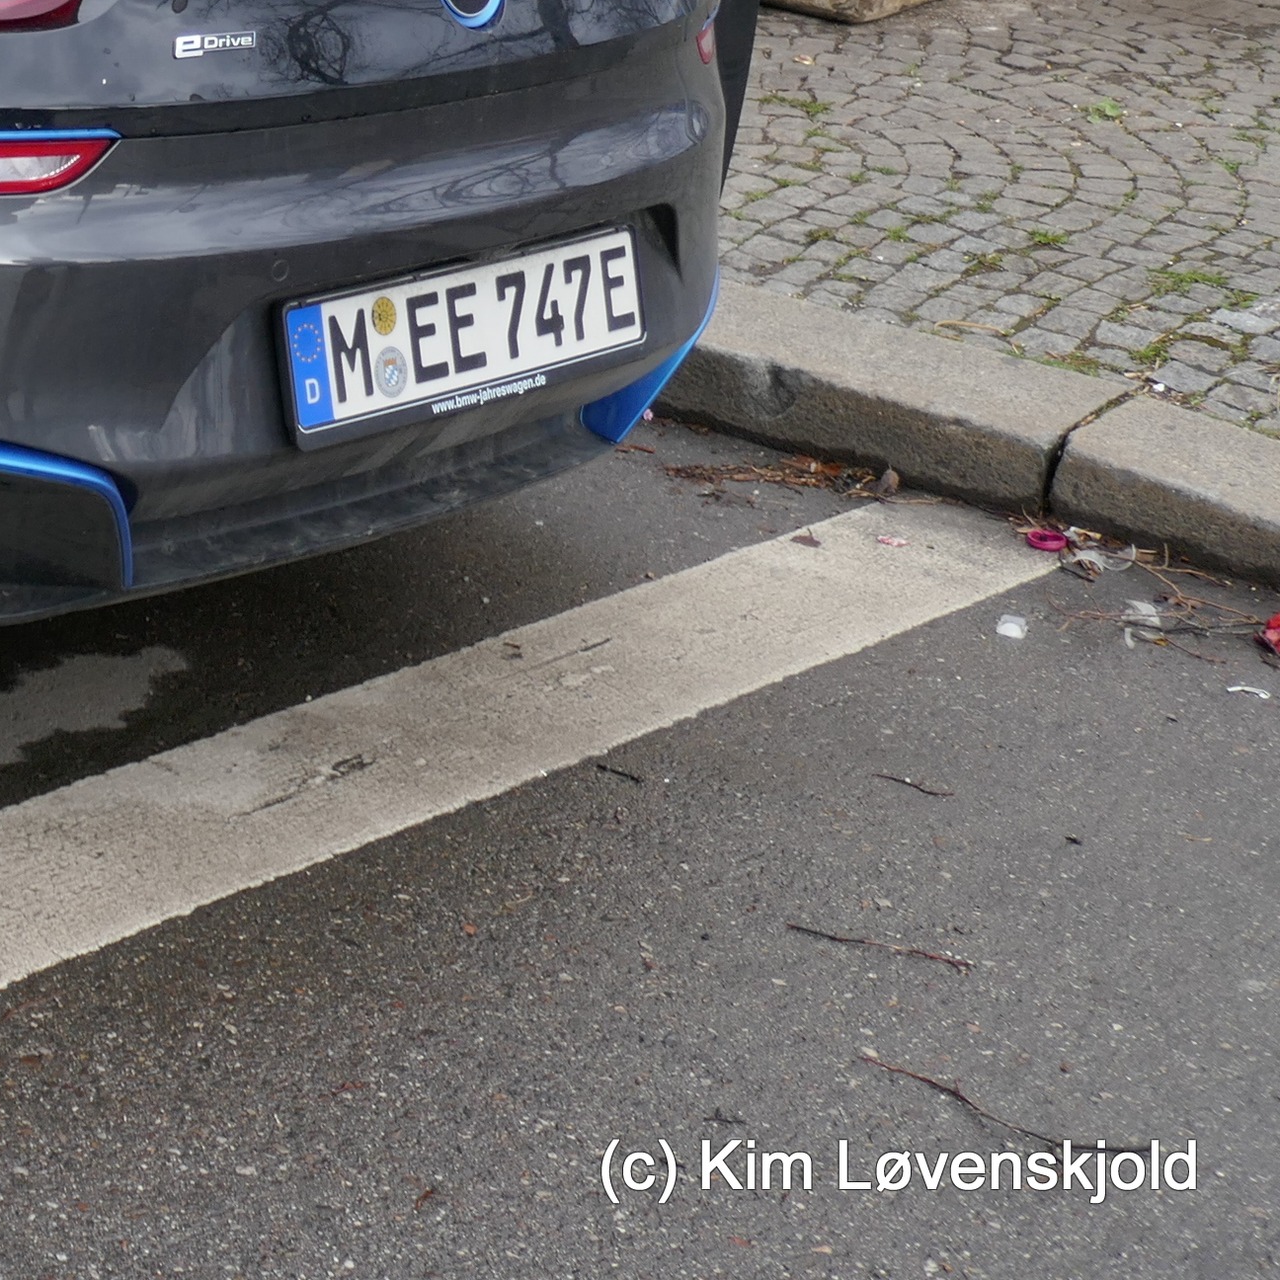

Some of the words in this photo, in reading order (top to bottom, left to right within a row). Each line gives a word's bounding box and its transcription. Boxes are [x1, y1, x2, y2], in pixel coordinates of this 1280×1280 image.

[327, 307, 375, 404] M
[405, 282, 488, 384] EE
[494, 244, 636, 360] 747E
[304, 377, 322, 405] D
[431, 373, 547, 415] www.bmw-jahreswagen.de
